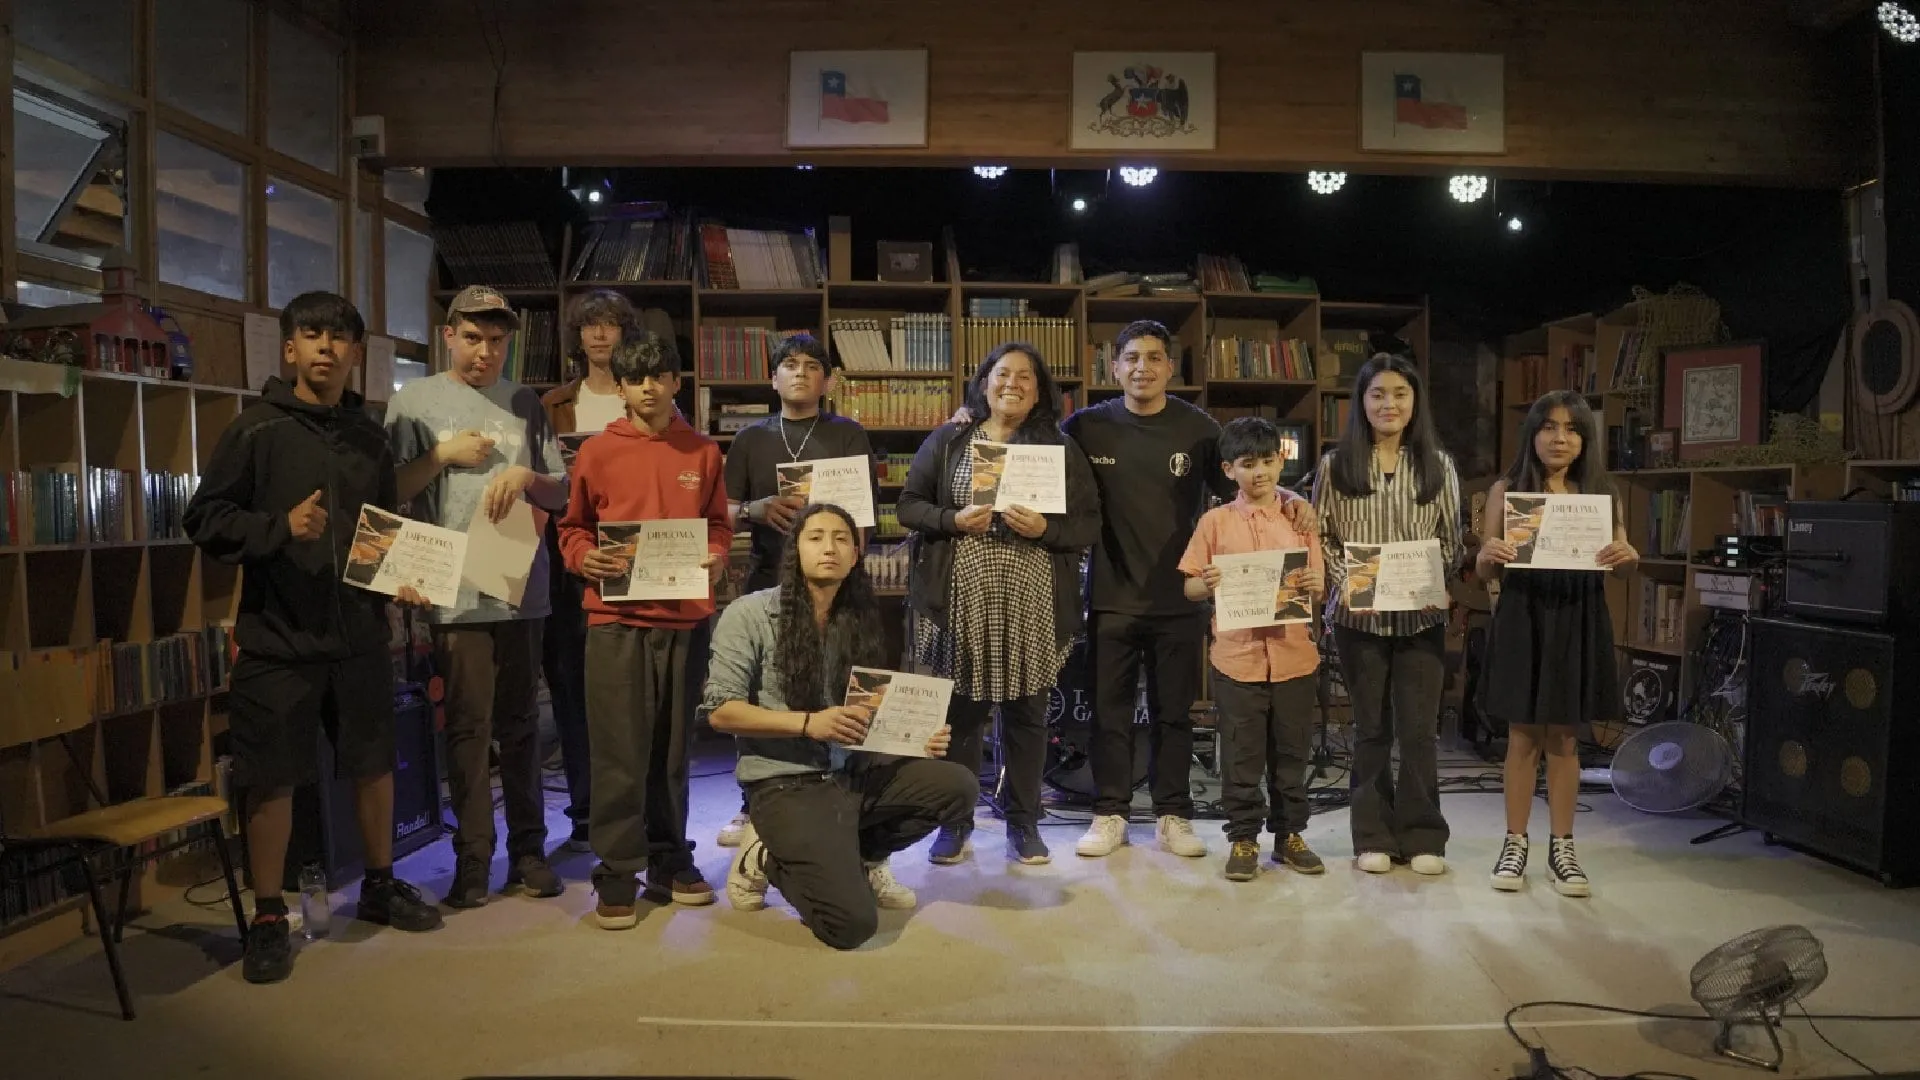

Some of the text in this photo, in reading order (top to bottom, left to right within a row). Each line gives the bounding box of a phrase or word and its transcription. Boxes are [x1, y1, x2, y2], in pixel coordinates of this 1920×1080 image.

[1011, 454, 1055, 463] DIPLOMA
[1552, 504, 1598, 514] DIPLOMA
[1790, 521, 1813, 533] Laney
[647, 530, 695, 540] DIPLOMA
[1387, 550, 1430, 560] DIPLOMA
[1227, 608, 1269, 619] DIPLOMA
[894, 684, 940, 699] DIPLOMA
[396, 809, 430, 838] Randall
